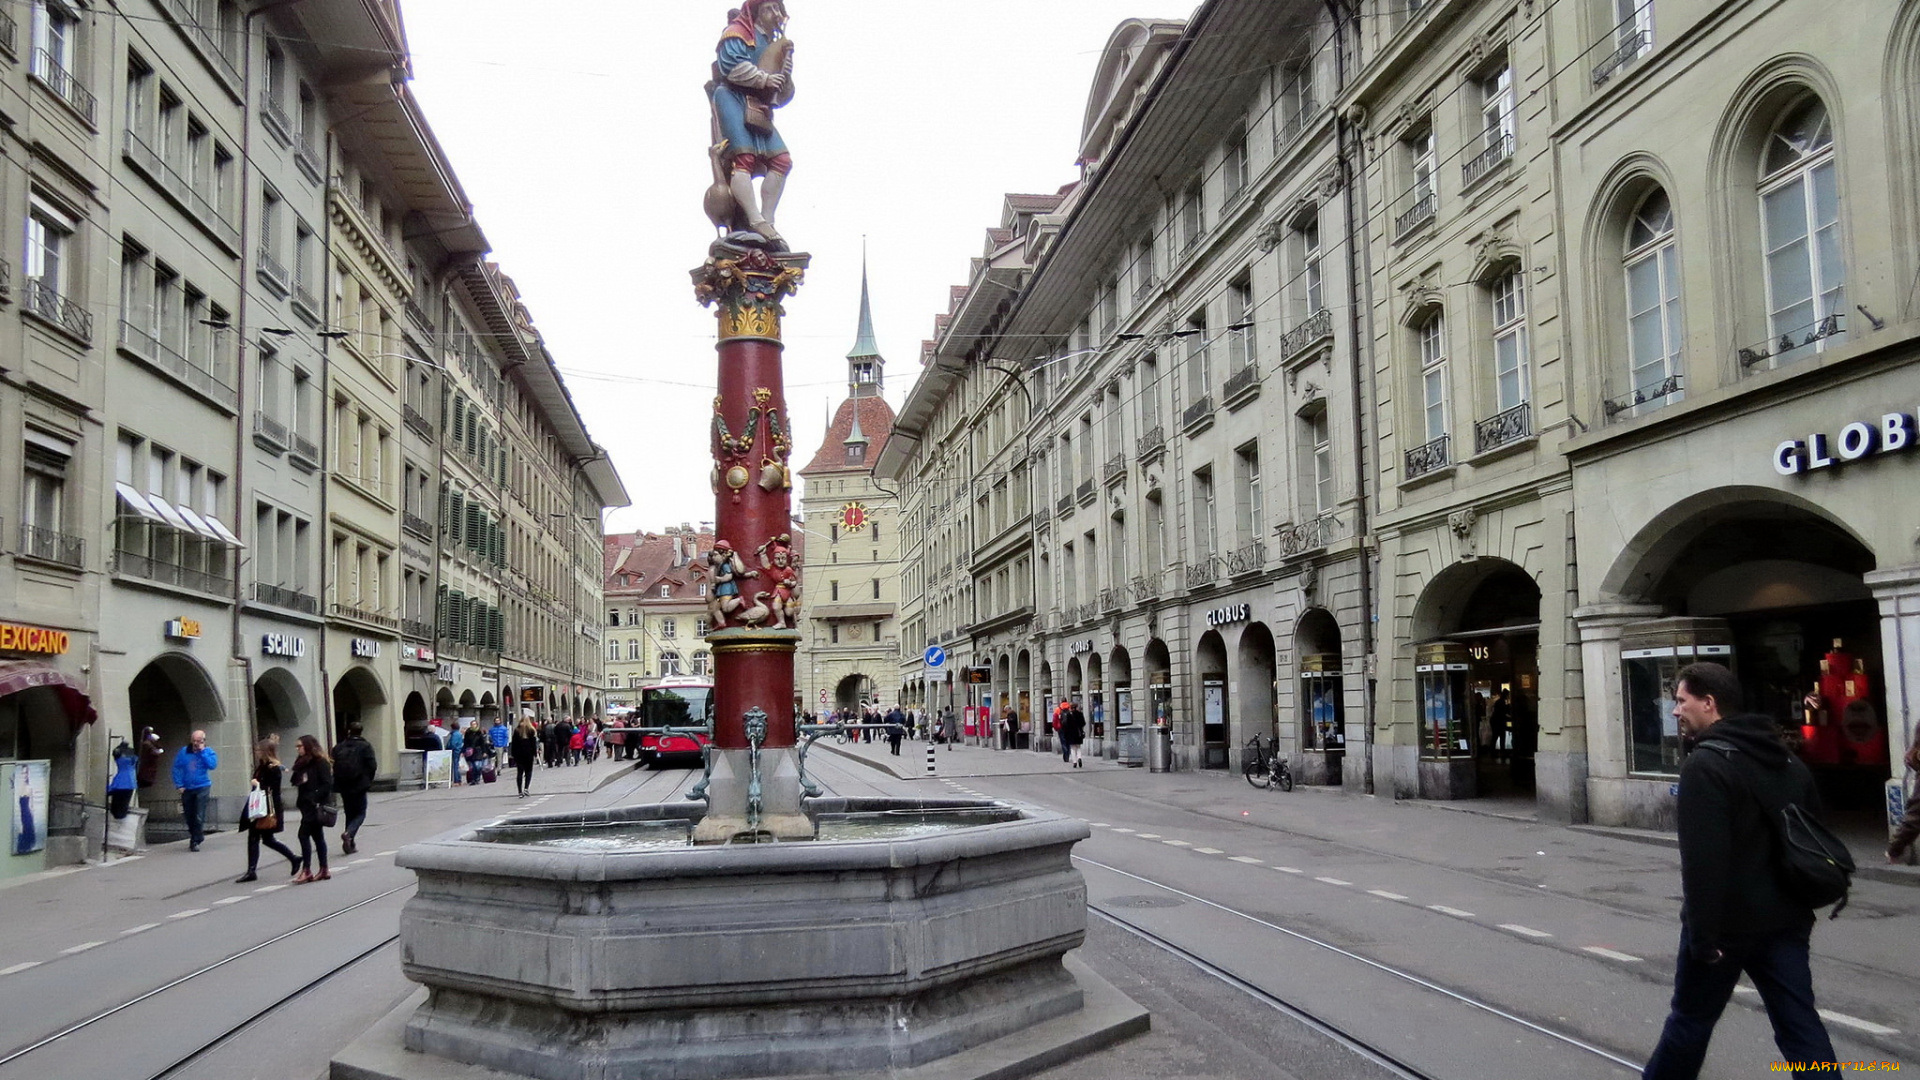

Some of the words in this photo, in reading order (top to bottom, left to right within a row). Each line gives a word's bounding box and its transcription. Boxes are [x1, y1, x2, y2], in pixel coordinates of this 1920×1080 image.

[1773, 405, 1920, 476] GLOB
[1205, 603, 1246, 627] GLOBUS
[267, 632, 305, 658] SCHILD
[355, 638, 381, 658] SCHILD
